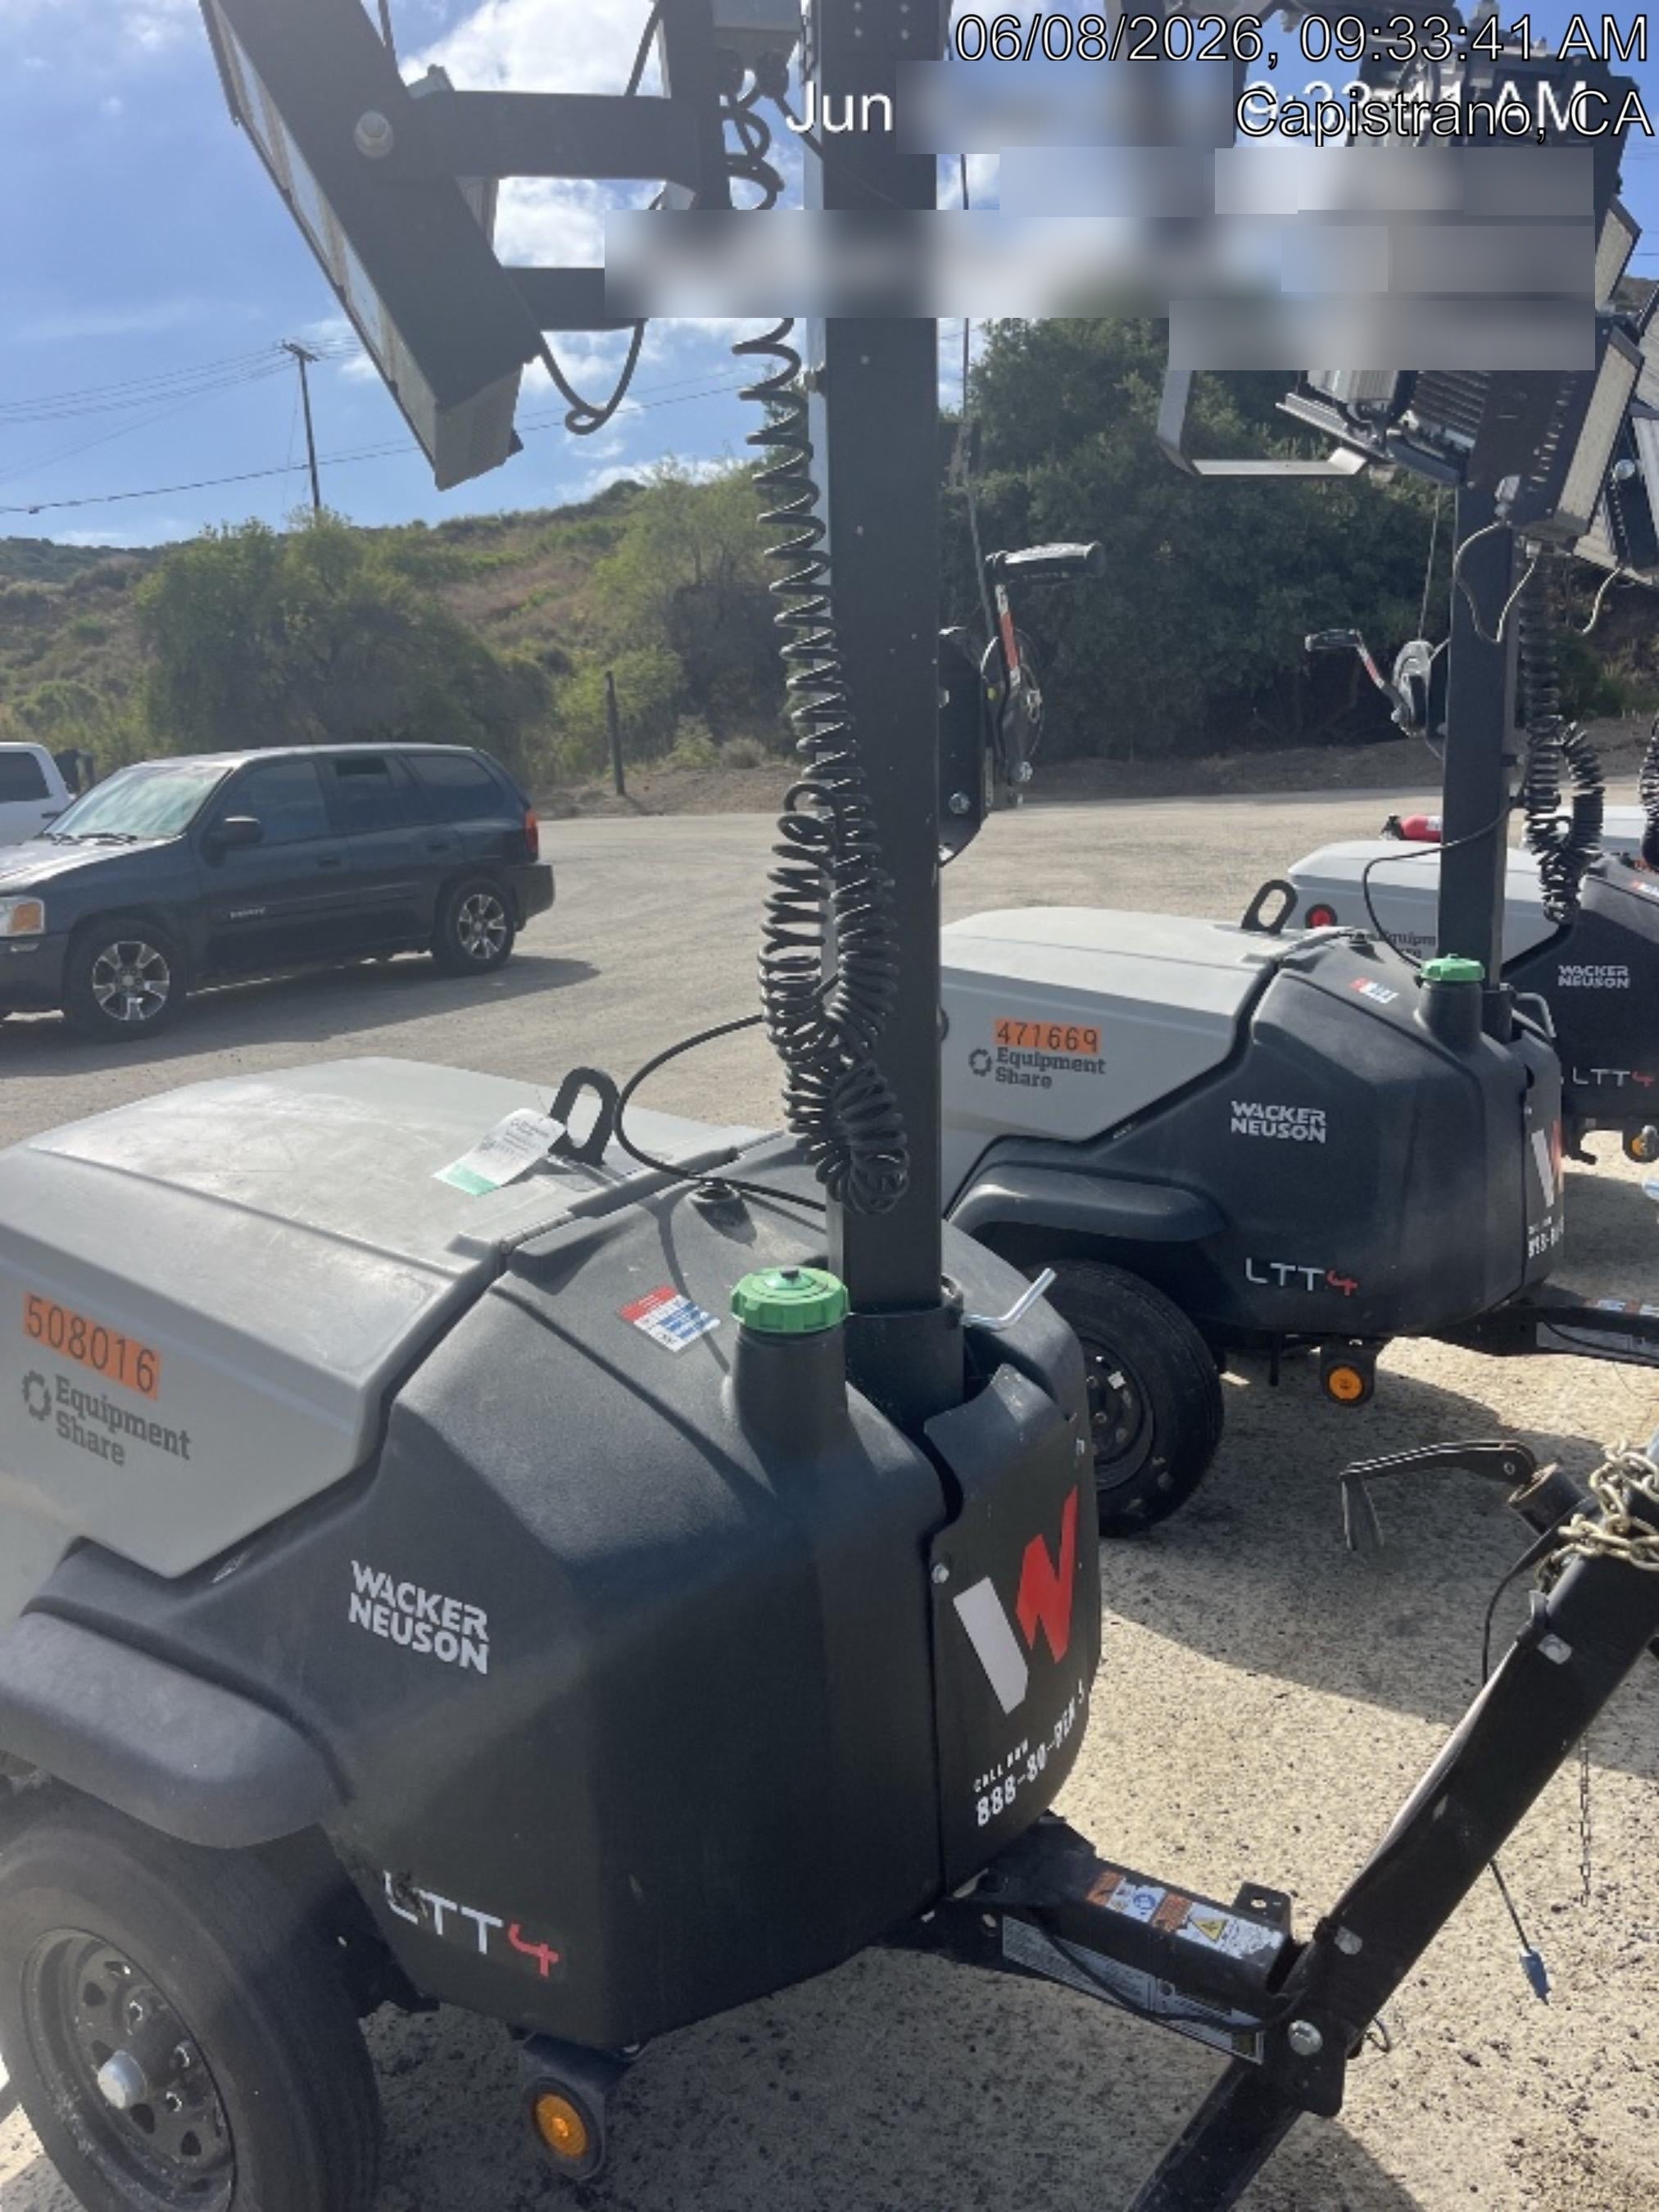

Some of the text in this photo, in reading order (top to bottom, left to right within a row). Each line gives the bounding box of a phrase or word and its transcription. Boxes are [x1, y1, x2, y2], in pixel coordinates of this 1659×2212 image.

[1558, 965, 1630, 977] WACKER
[1558, 975, 1631, 989] NEUSON
[997, 1022, 1098, 1053] 471669
[996, 1046, 1107, 1075] Equipment
[995, 1067, 1053, 1089] Share
[1572, 1066, 1655, 1088] LTT4
[1231, 1100, 1327, 1126] WACKER
[1231, 1117, 1326, 1144] NEUSON
[1245, 1258, 1358, 1296] LTT4
[27, 1294, 156, 1394] 508016
[54, 1373, 192, 1462] Equipment
[55, 1409, 125, 1467] Share
[350, 1559, 490, 1642] WACKER
[348, 1591, 490, 1675] NEUSON
[383, 1870, 560, 1977] LTT4
